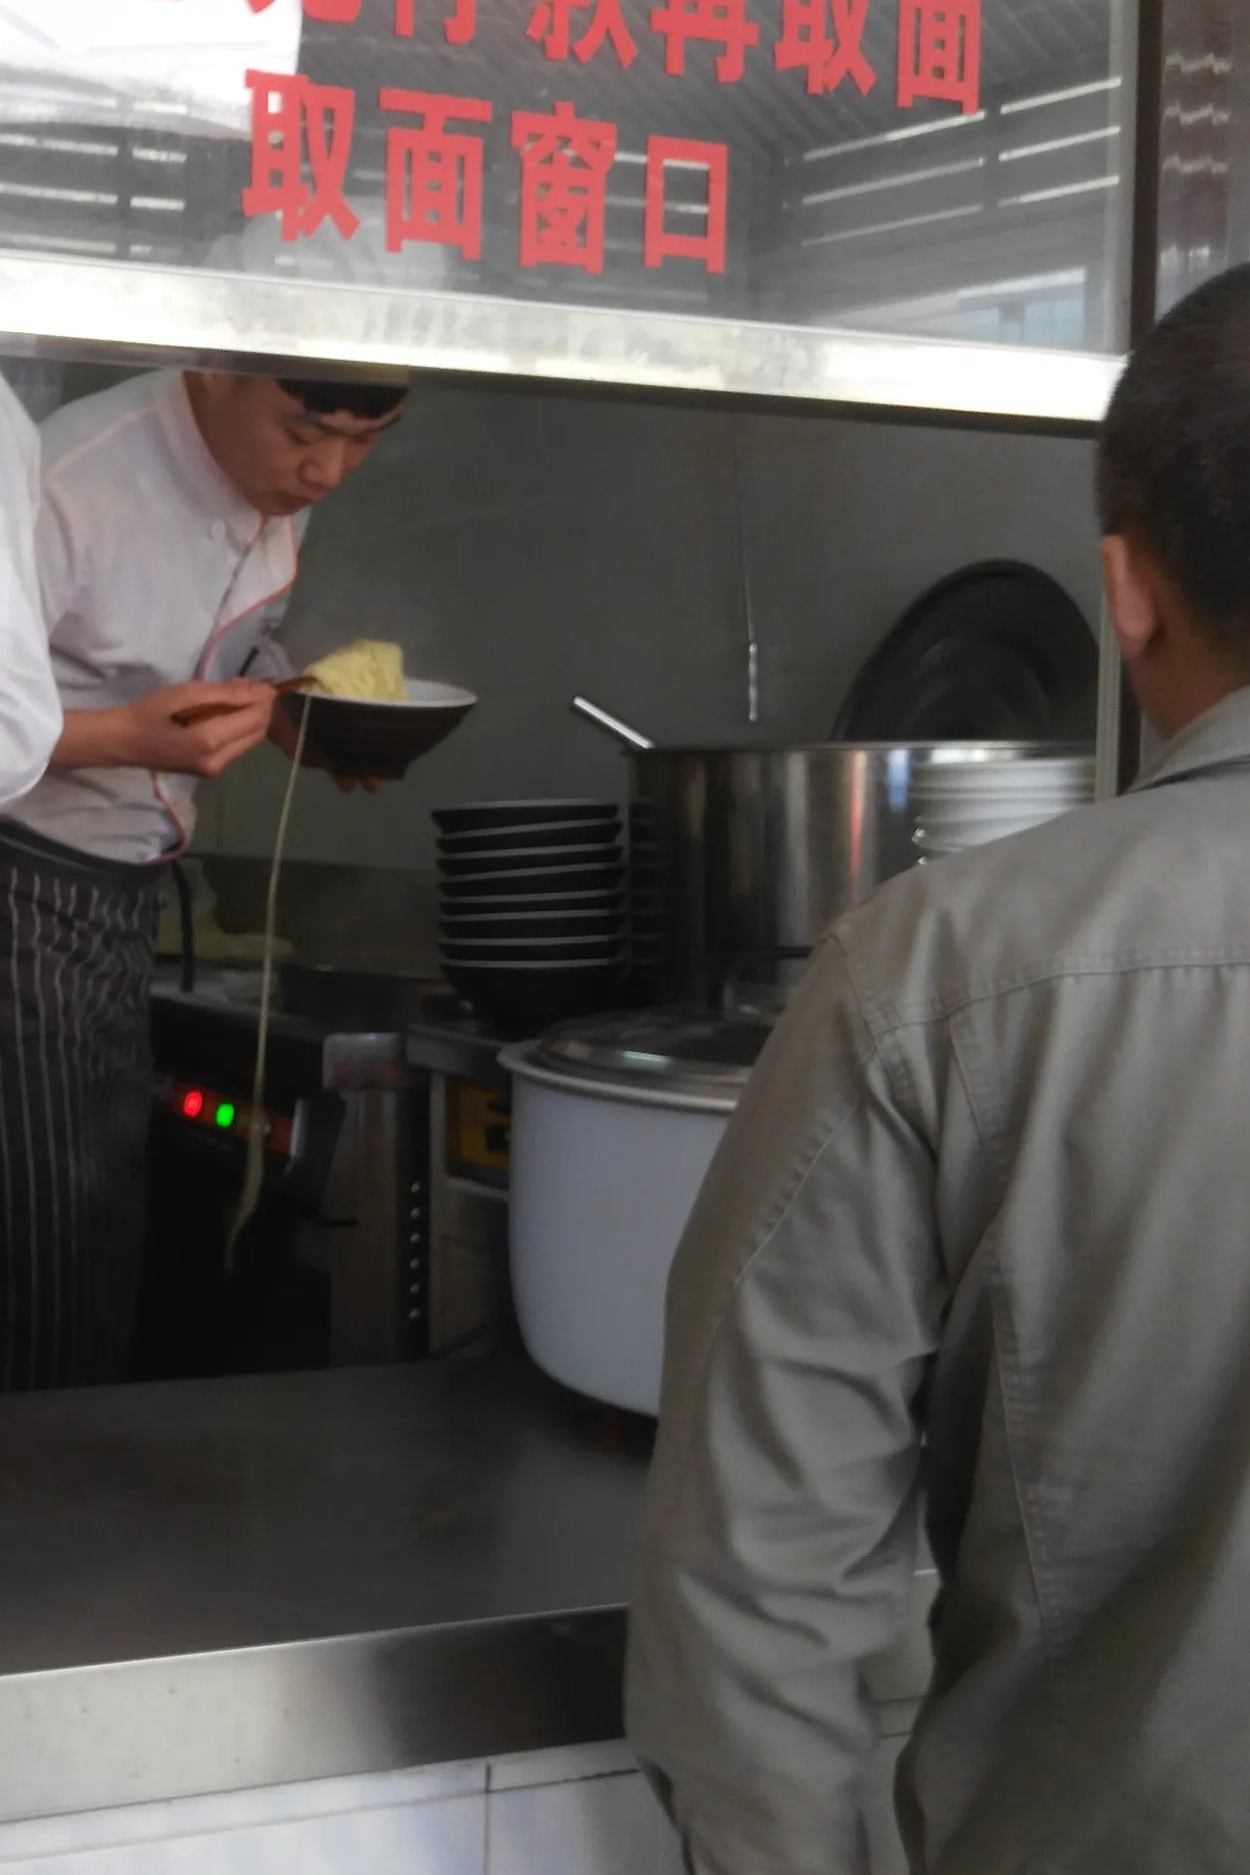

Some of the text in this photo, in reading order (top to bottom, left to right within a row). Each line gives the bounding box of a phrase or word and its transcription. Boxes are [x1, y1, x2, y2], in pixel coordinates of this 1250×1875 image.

[248, 0, 981, 115] 再取面
[241, 69, 729, 274] 取面窗口
